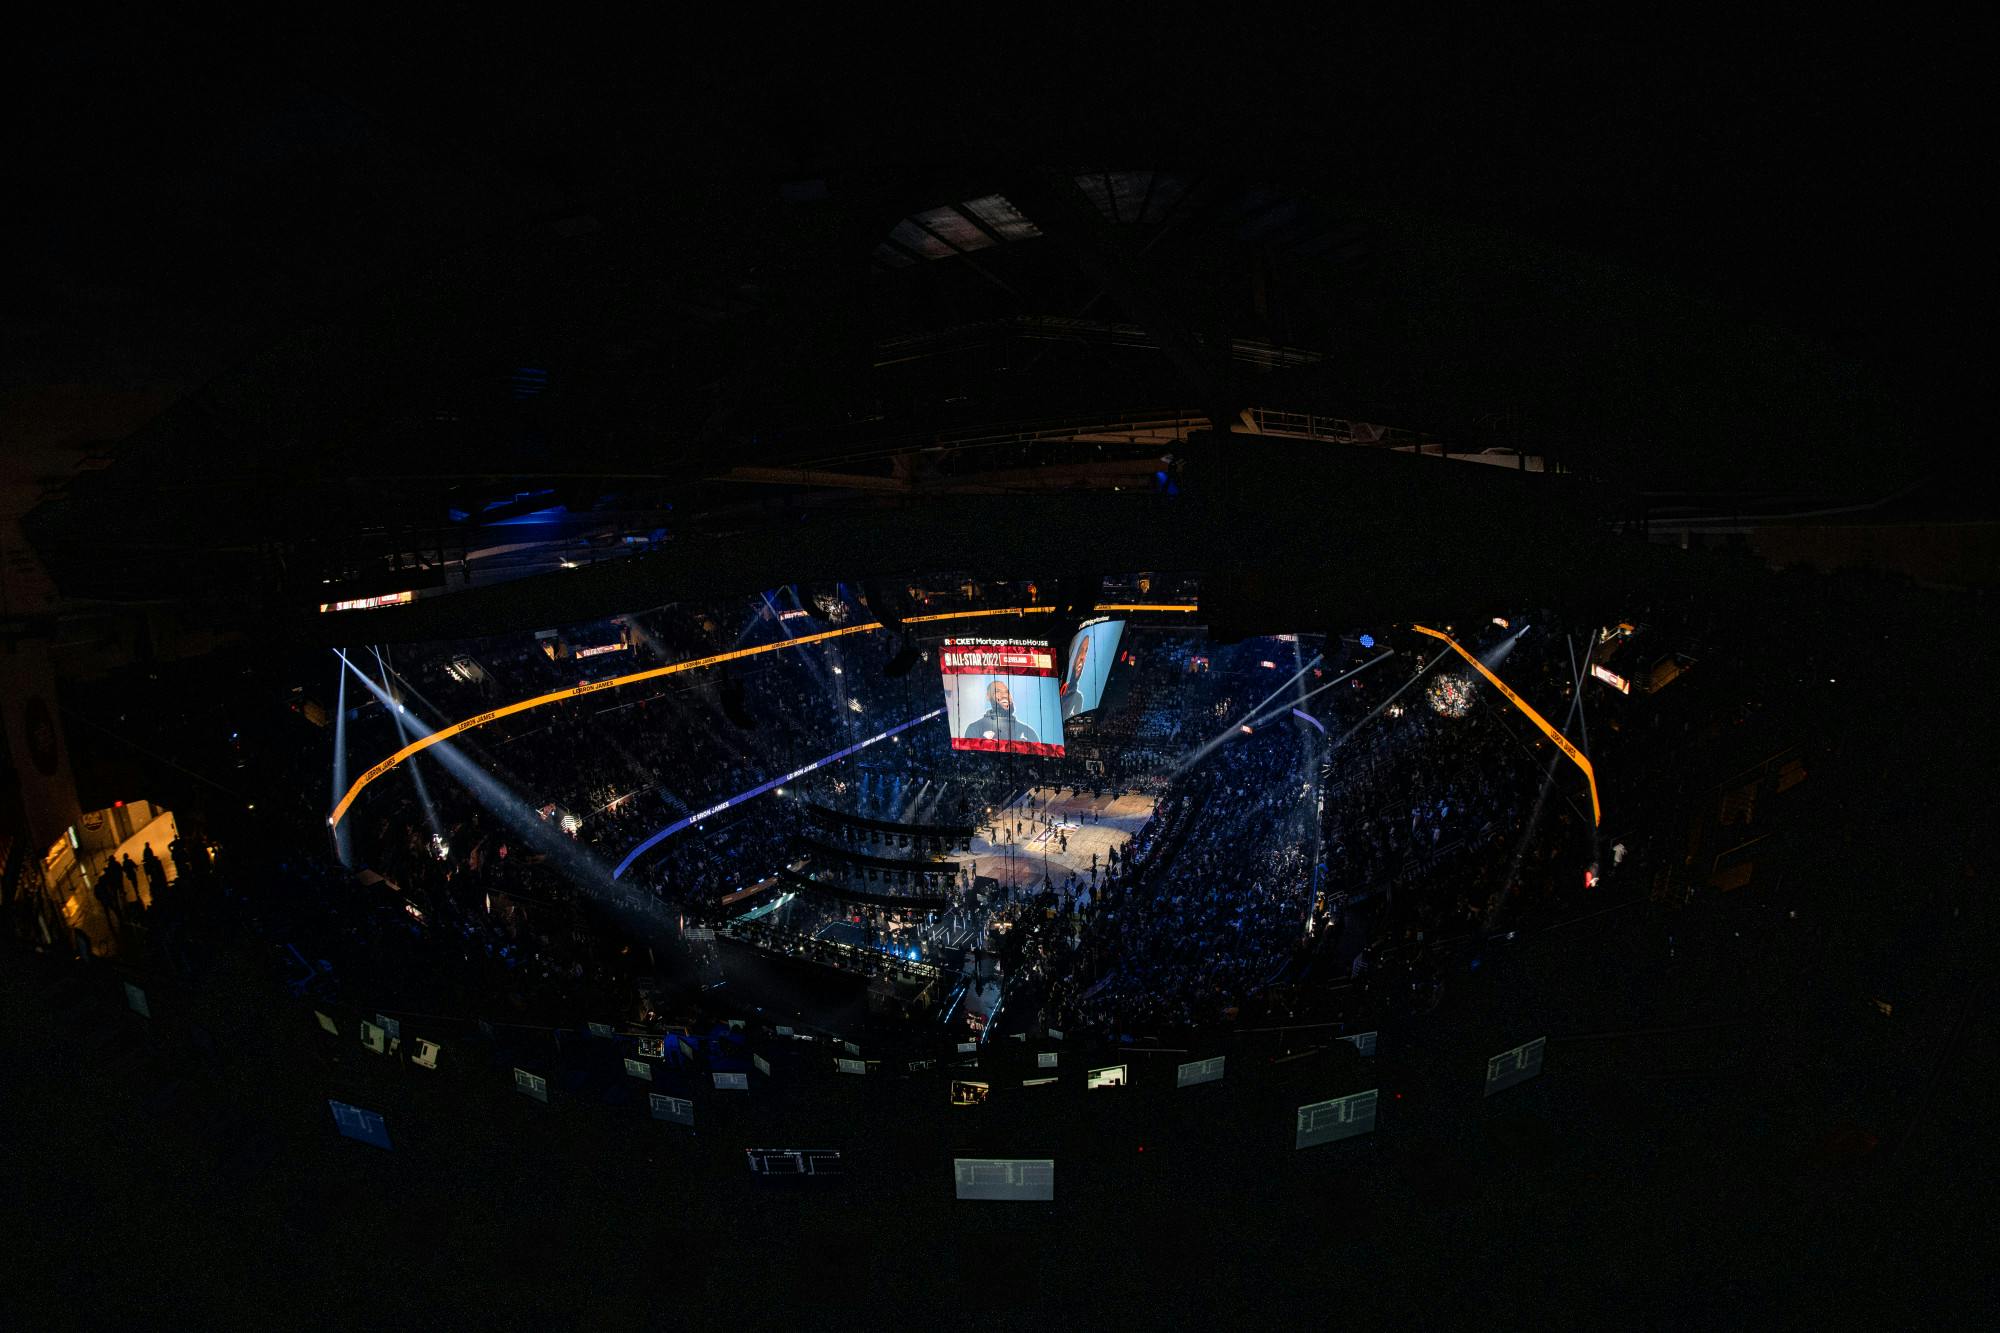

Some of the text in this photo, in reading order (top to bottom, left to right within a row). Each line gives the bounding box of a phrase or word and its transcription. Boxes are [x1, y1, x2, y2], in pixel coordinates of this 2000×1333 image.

[944, 637, 975, 646] ROCKET
[975, 637, 1008, 647] Mortgage
[982, 652, 1000, 667] 2022
[595, 680, 614, 689] JAMES
[457, 712, 496, 731] LEBRON JAMES
[365, 756, 396, 782] LEBRON JAMES
[711, 801, 730, 814] JAMES
